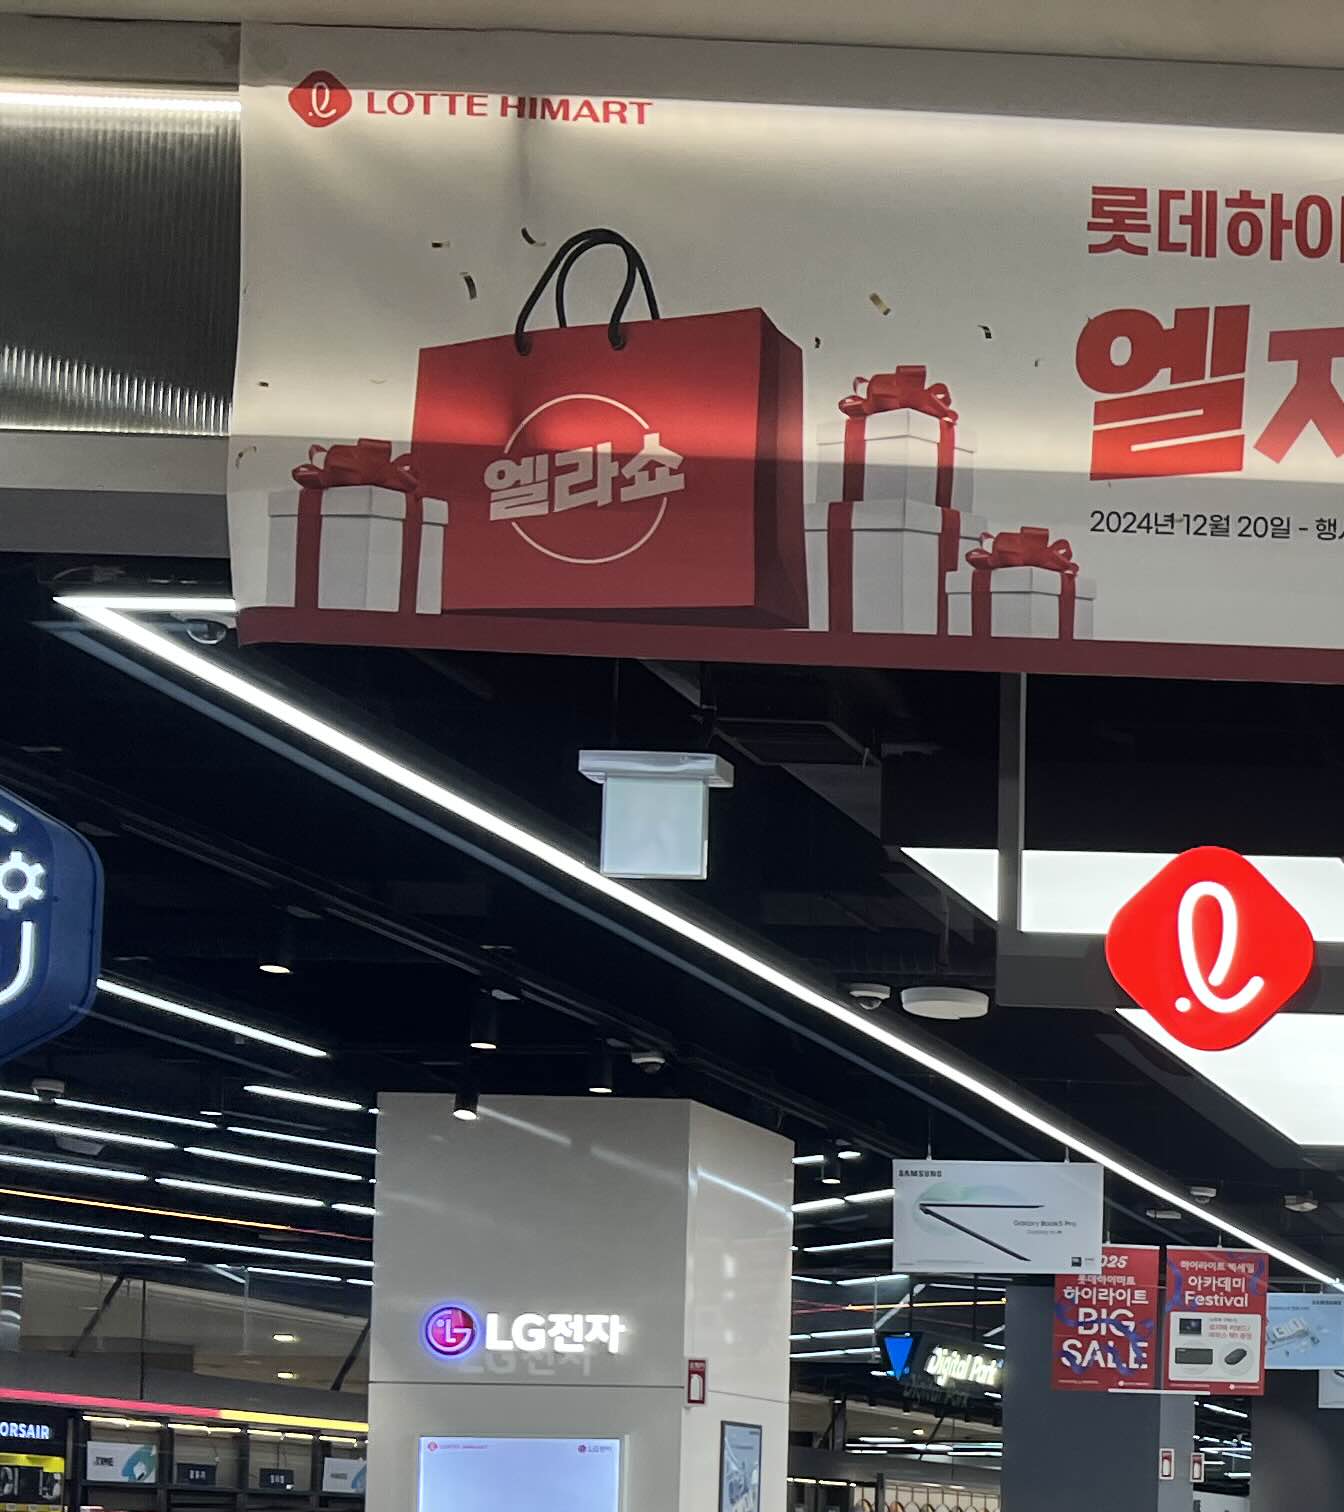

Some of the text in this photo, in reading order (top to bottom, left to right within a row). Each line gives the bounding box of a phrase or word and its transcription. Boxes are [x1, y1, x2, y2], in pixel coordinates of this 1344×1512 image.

[366, 90, 653, 126] LOTTE HIMART
[483, 432, 686, 524] 엘라쇼
[1089, 510, 1176, 538] 2024년
[1183, 513, 1232, 539] 12월
[1237, 515, 1292, 541] 20일
[899, 1170, 942, 1178] SAMSUNG
[1101, 1256, 1128, 1269] 025
[1063, 1287, 1149, 1307] 하이라이트
[1188, 1276, 1245, 1292] 아카데미
[1184, 1291, 1249, 1308] Festival
[485, 1312, 627, 1354] LG전자
[1078, 1307, 1135, 1336] BIG
[925, 1344, 972, 1387] Digital
[1060, 1339, 1149, 1369] SALE
[0, 1421, 51, 1440] ORSAIR
